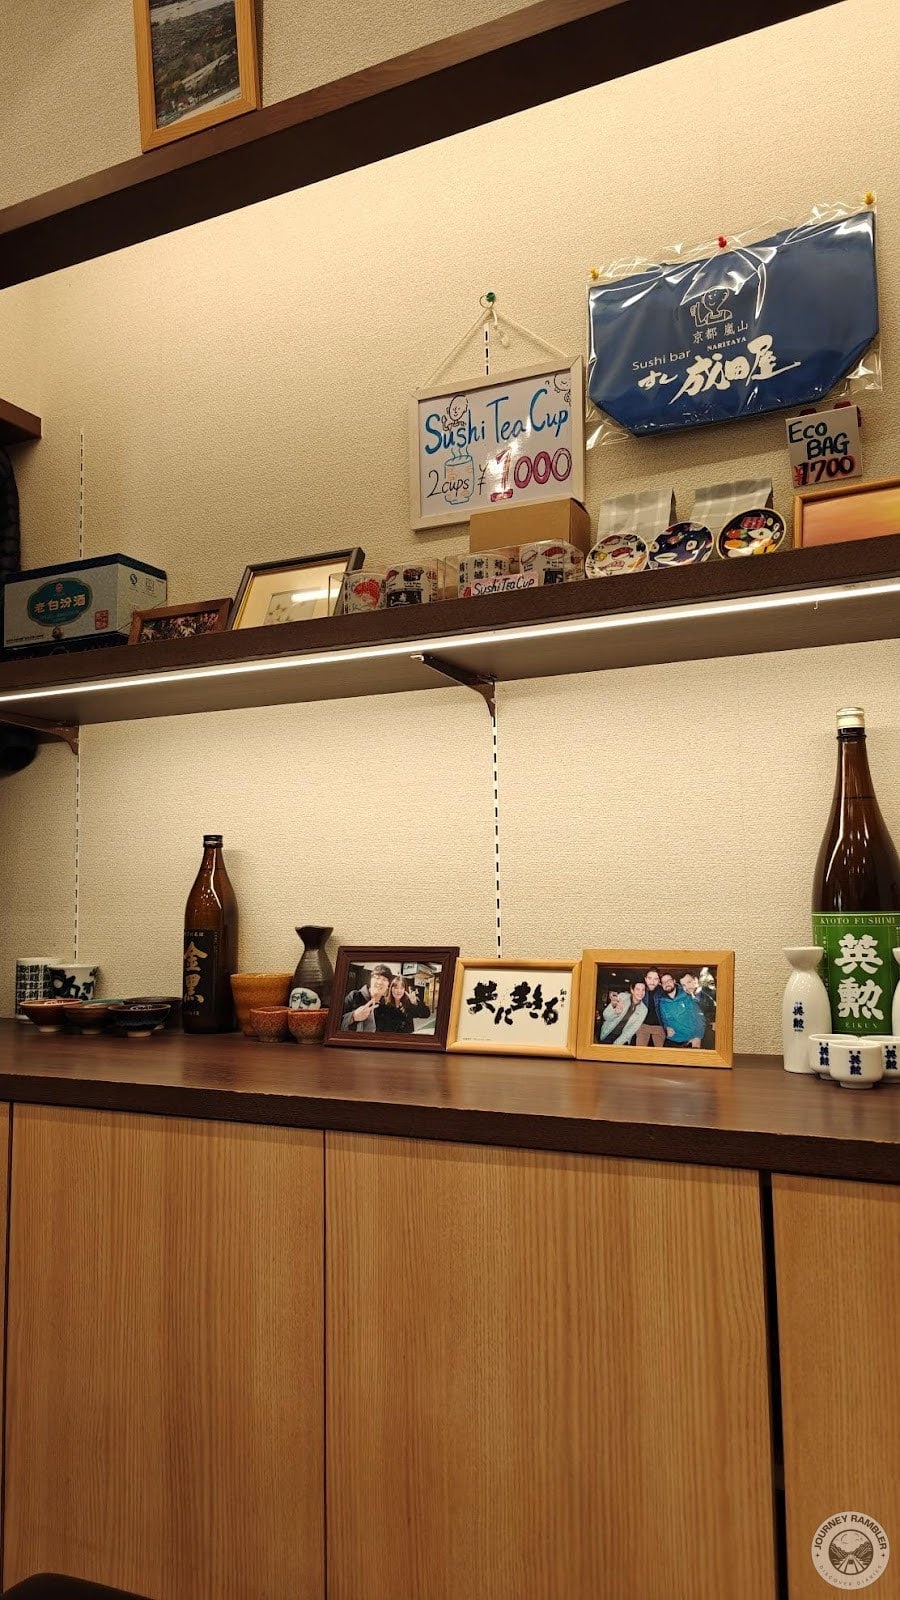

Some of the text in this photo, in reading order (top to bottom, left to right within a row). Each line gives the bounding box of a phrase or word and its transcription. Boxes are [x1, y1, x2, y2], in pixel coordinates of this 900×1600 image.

[692, 319, 749, 344] 京都 嵐山
[706, 336, 747, 352] NARITAYA
[632, 350, 692, 371] Sushi bar
[424, 388, 569, 455] Sushi Tea Cup
[806, 432, 850, 461] BAG
[794, 455, 856, 487] ¥1700
[472, 577, 501, 596] Sushi
[515, 575, 535, 590] Cup
[34, 593, 86, 614] 老白汾酒
[820, 916, 895, 925] KYOTO FUSHIMI
